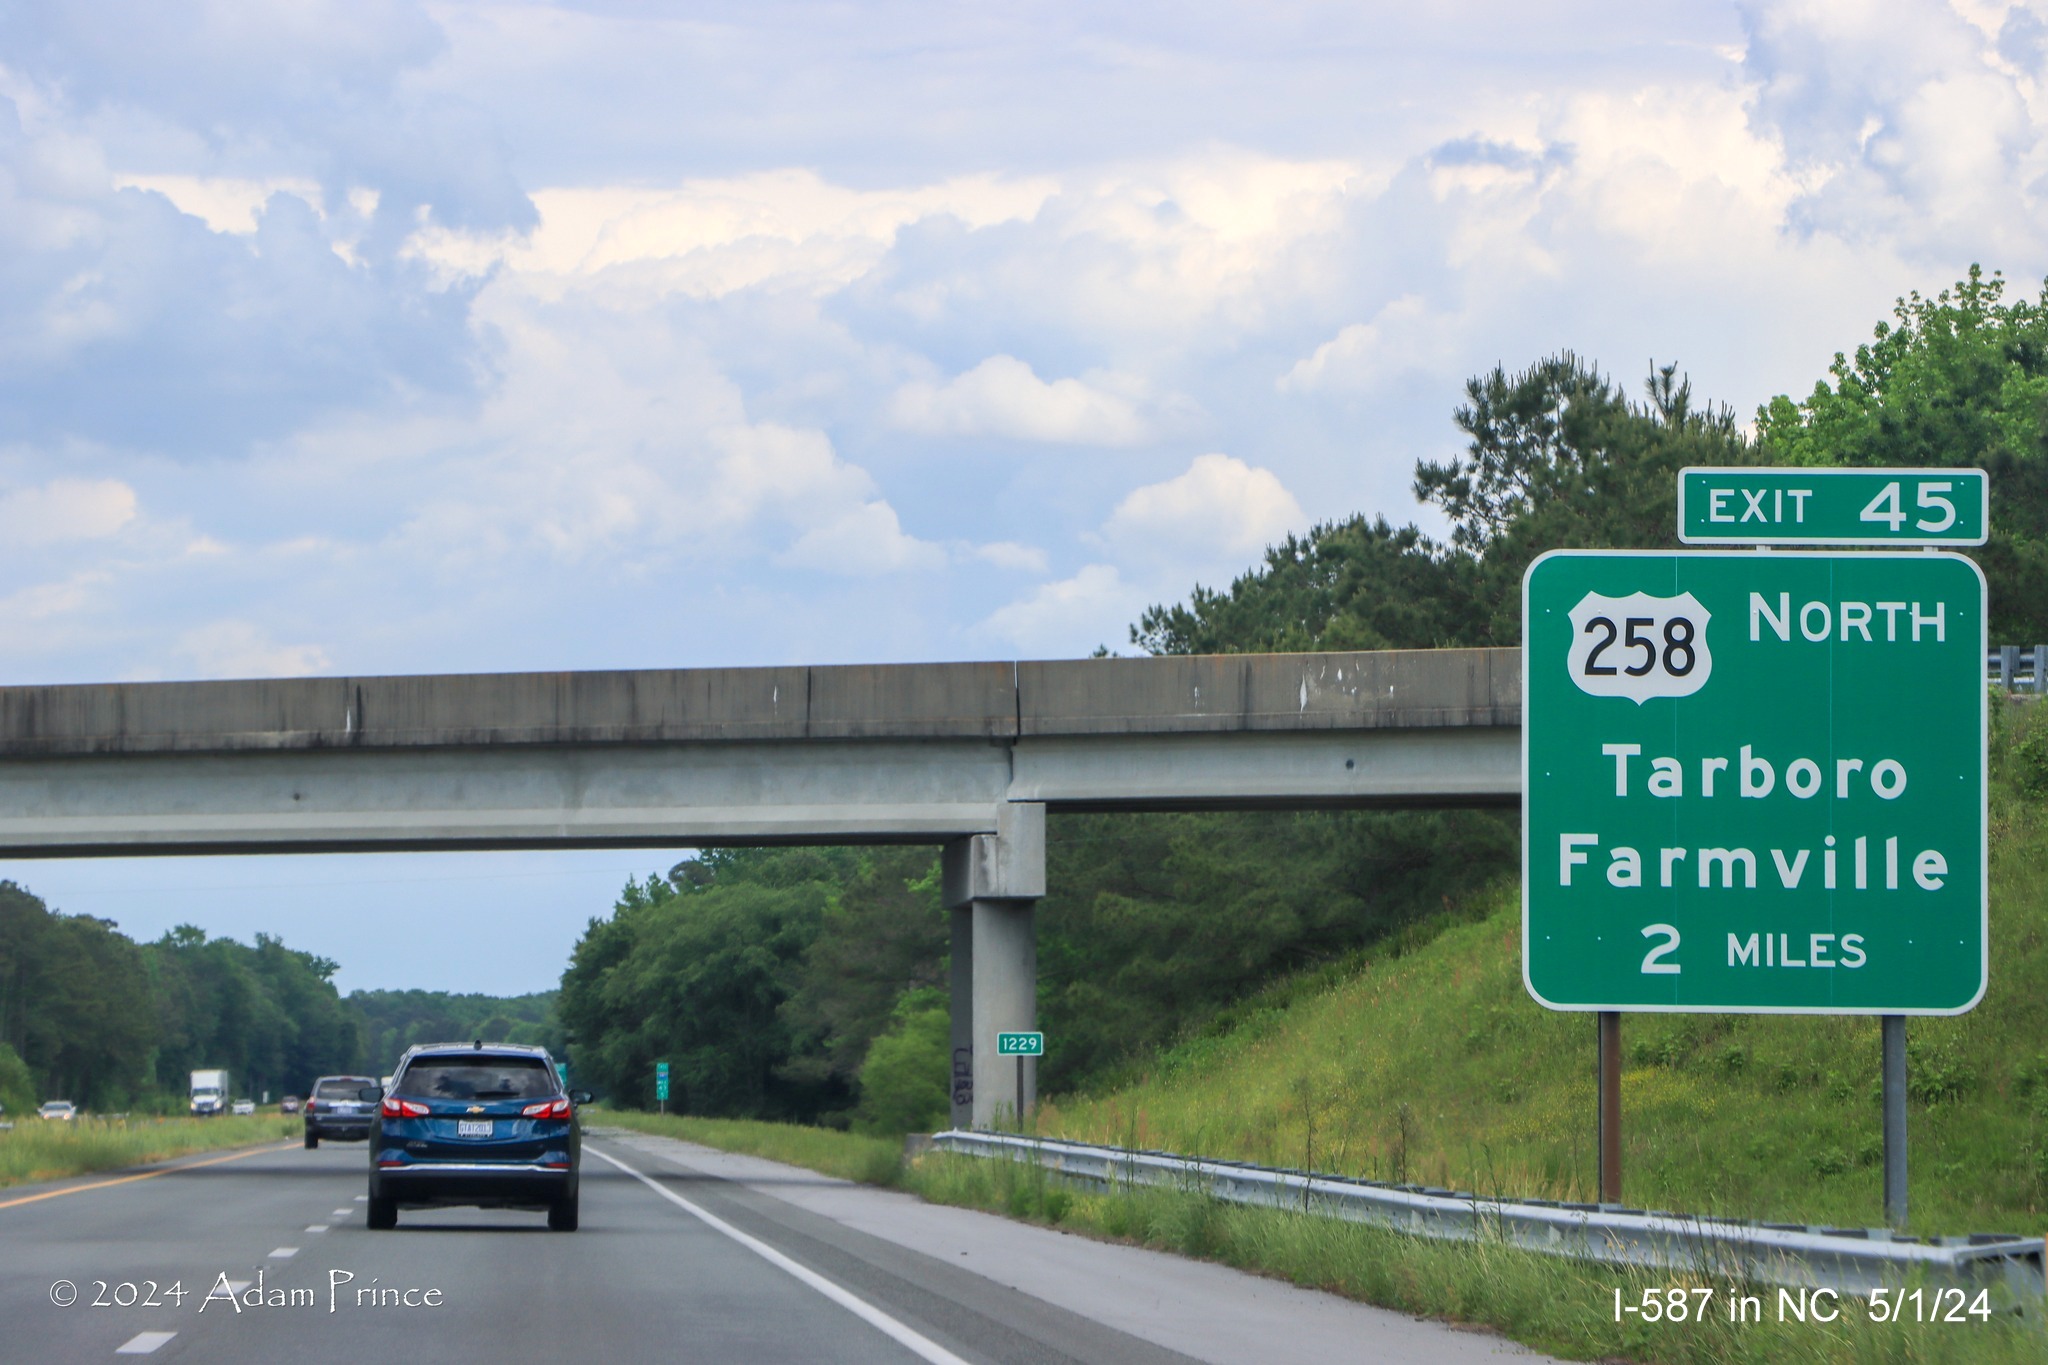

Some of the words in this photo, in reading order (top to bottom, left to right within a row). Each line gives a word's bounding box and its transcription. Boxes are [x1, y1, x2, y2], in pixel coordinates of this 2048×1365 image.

[1708, 488, 1813, 524] EXIT
[1859, 481, 1958, 533] 45
[1749, 591, 1947, 643] NORTH
[1583, 616, 1697, 677] 258
[1601, 743, 1909, 801] Tarboro
[1559, 832, 1950, 891] Farmville
[1640, 923, 1682, 975] 2
[1727, 932, 1868, 969] MILES
[1003, 1037, 1037, 1051] 1229
